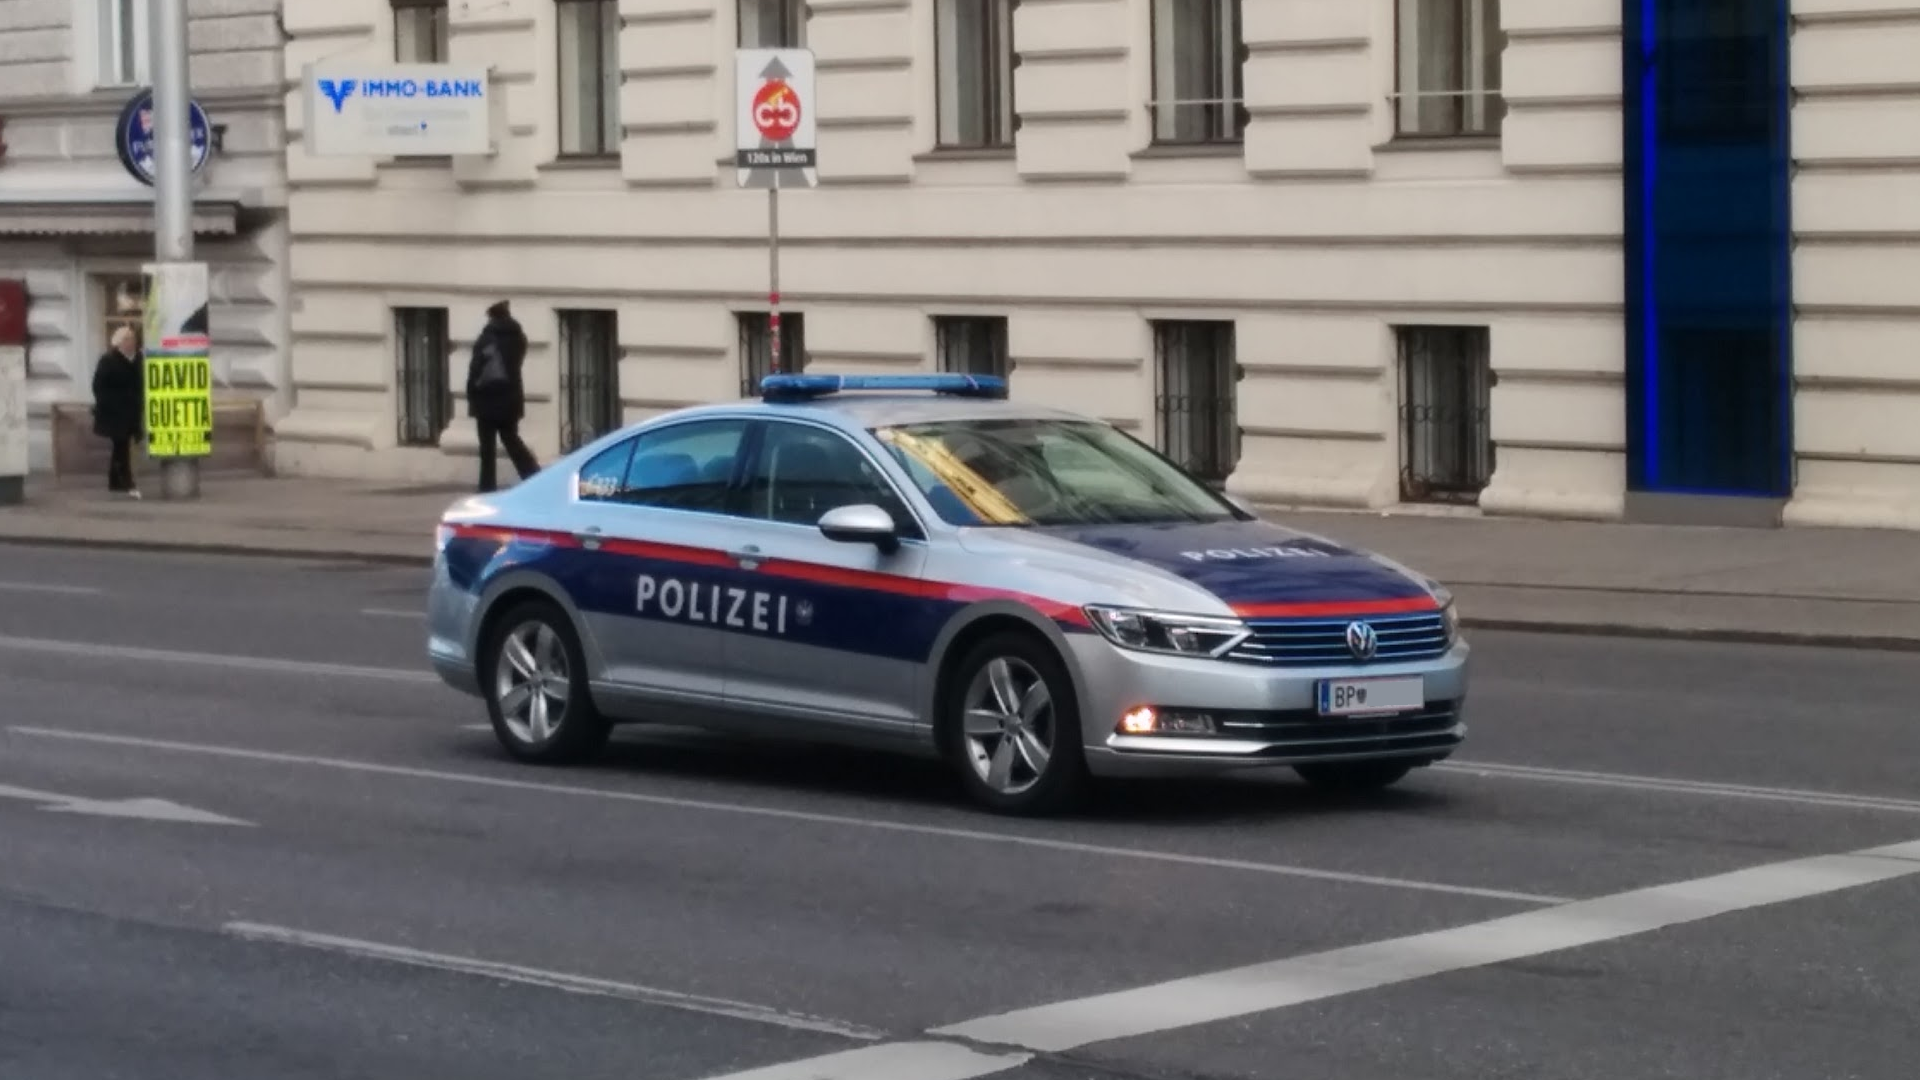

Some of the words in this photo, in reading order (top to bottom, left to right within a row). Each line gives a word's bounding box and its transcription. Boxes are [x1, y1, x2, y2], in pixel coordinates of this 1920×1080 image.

[362, 79, 483, 98] IMMO-BANK
[772, 151, 782, 164] in
[784, 151, 808, 164] Wien
[149, 361, 208, 390] DAVID
[149, 398, 210, 427] GUETTA
[1180, 547, 1331, 561] POLIZEI
[637, 574, 787, 634] POLIZEI
[1335, 685, 1355, 708] BP
